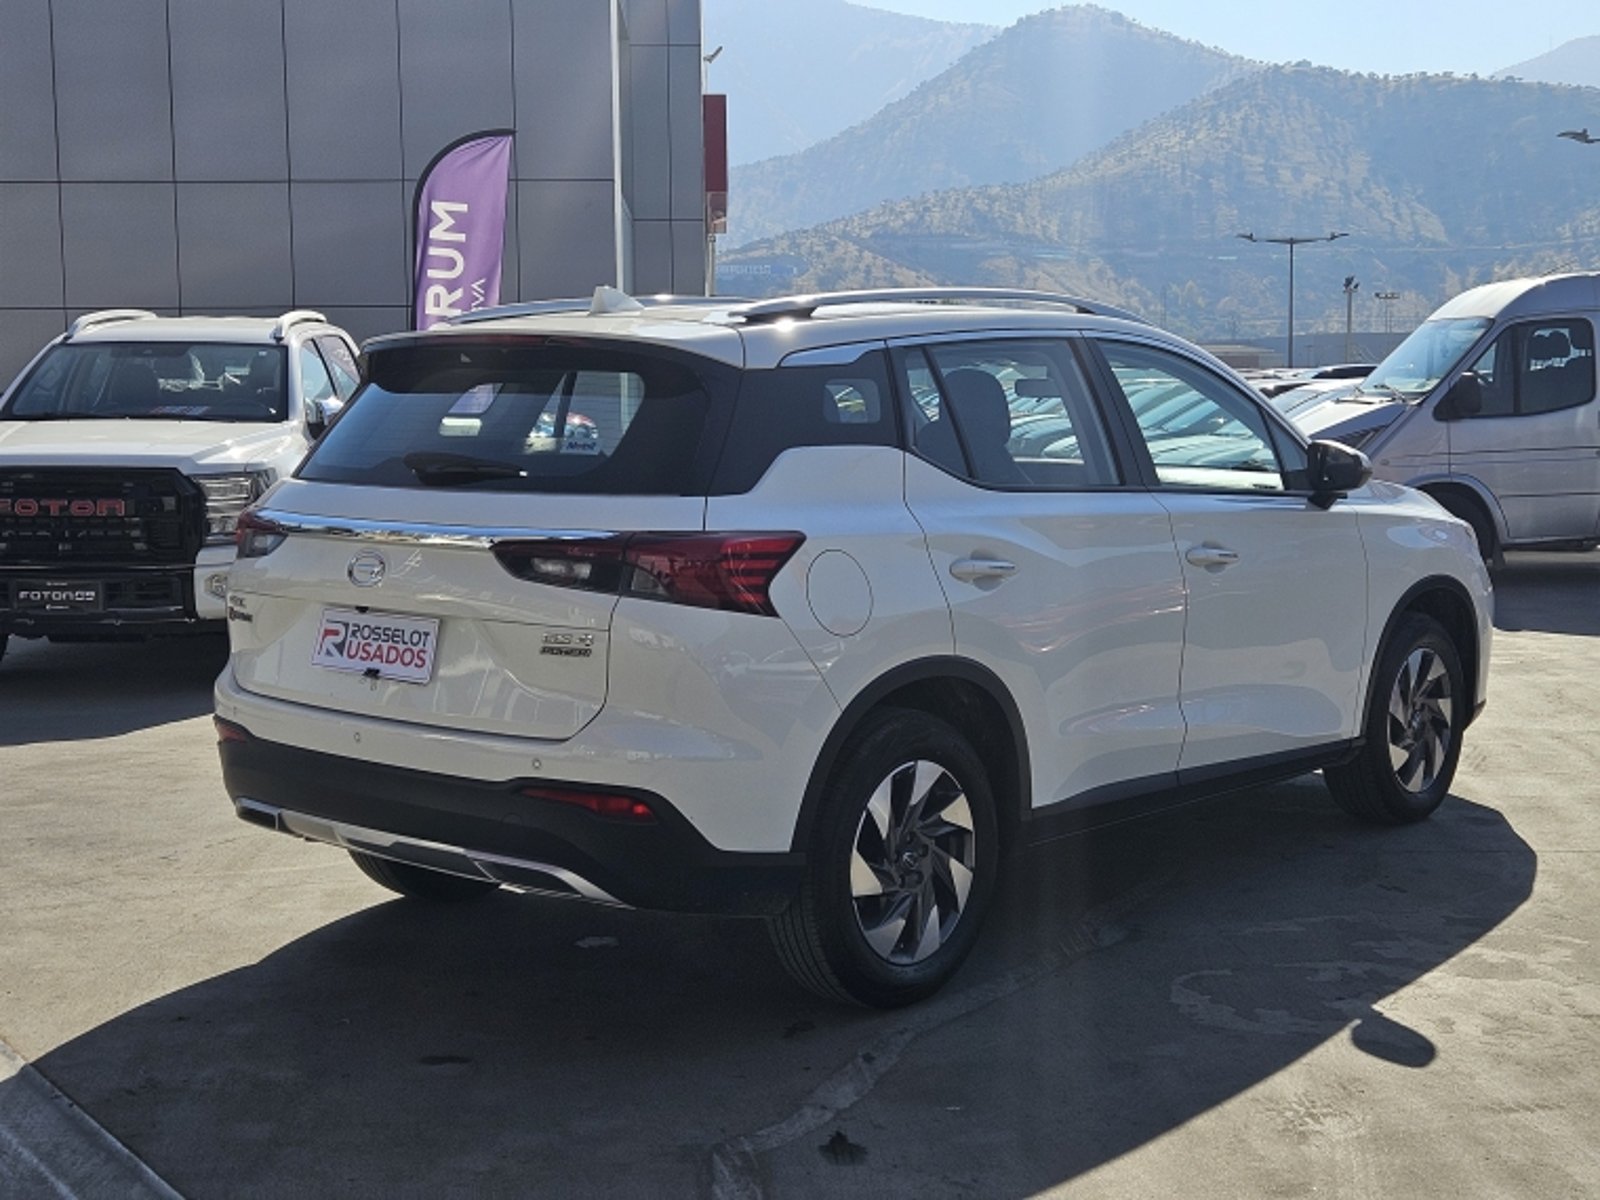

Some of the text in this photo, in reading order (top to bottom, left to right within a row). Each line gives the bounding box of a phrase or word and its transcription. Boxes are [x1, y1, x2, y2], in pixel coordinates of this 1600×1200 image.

[425, 200, 468, 331] RUM
[471, 279, 486, 312] VA
[349, 622, 431, 648] ROSSELOT
[346, 640, 427, 669] USADOS
